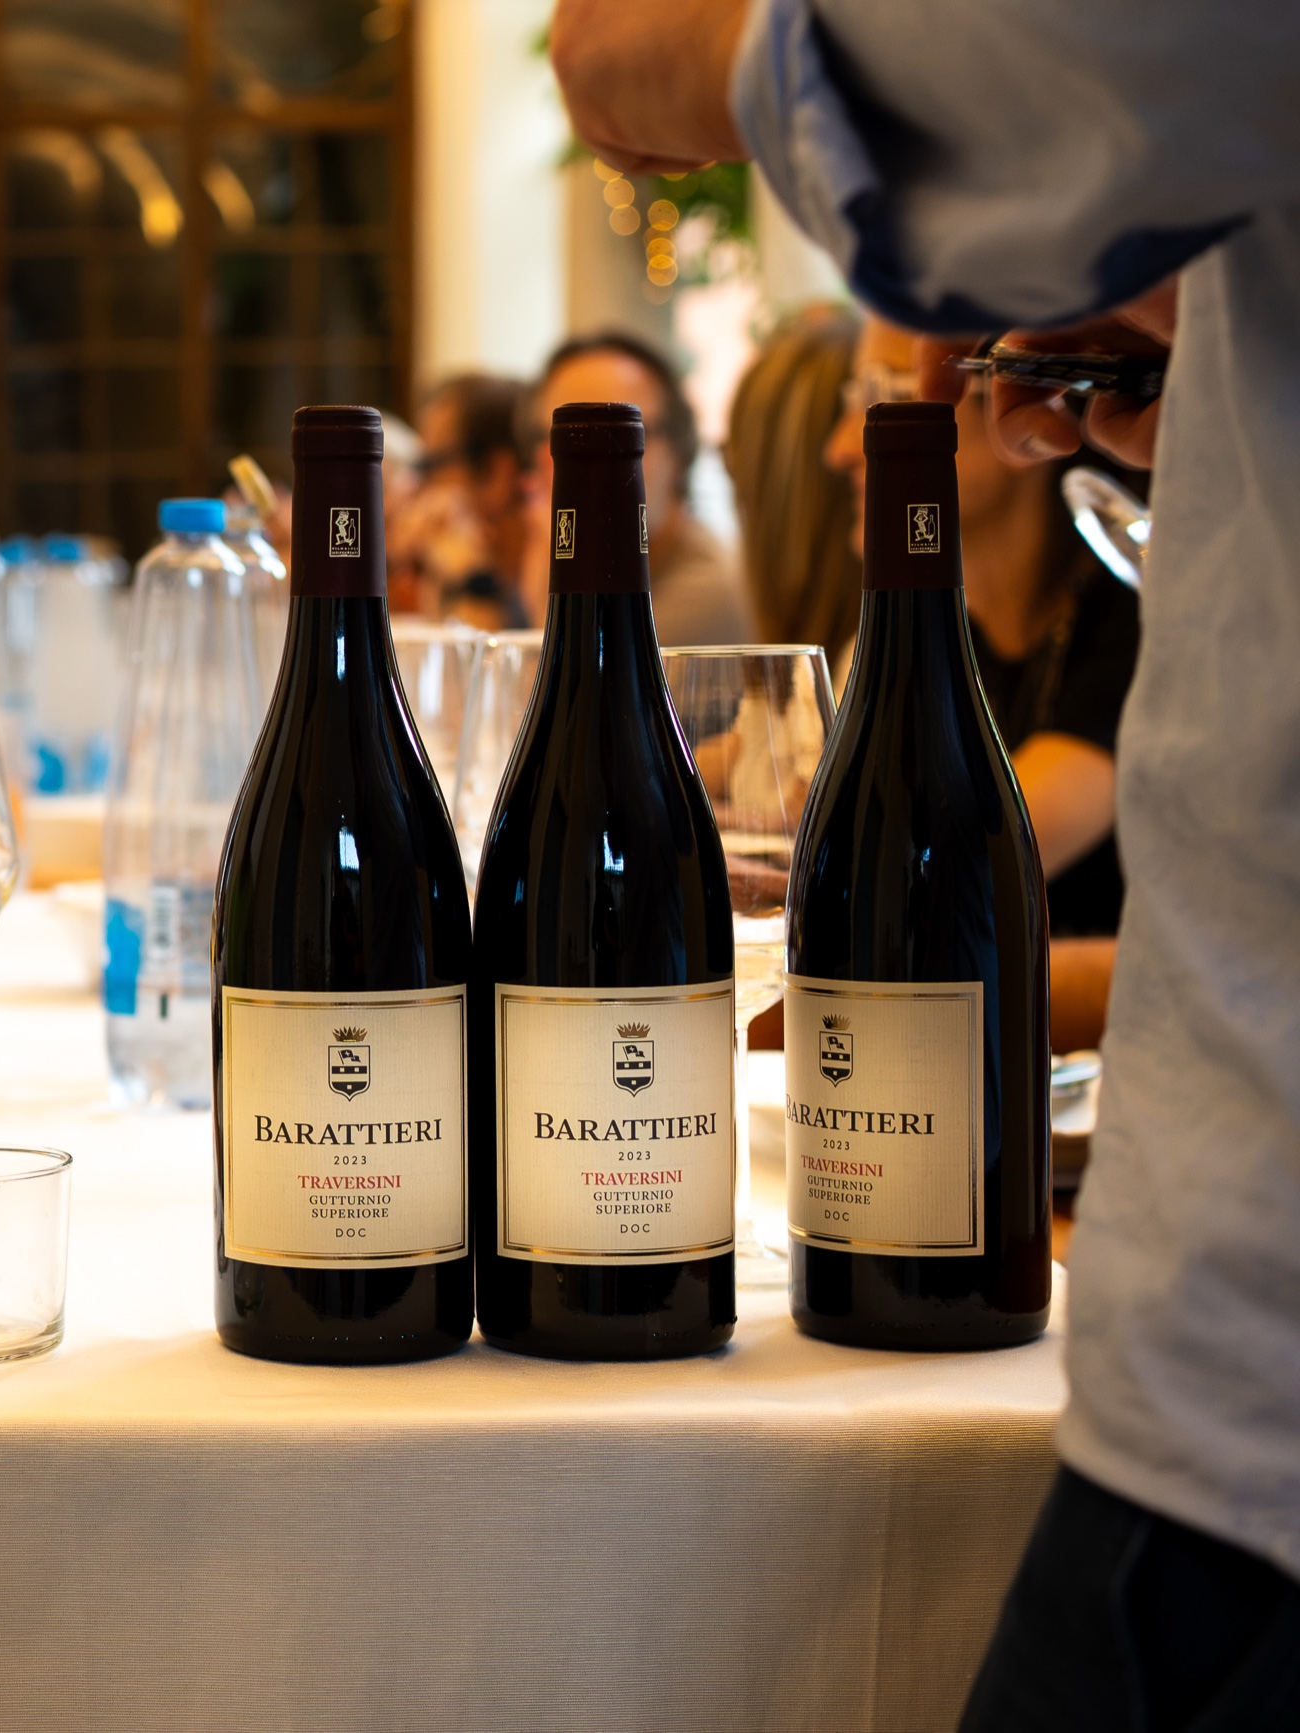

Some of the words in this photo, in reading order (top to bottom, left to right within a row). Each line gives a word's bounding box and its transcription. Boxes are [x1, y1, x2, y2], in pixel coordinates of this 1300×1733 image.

[786, 1093, 935, 1135] BARATTIERI
[254, 1115, 442, 1145] BARATTIERI
[534, 1112, 717, 1141] BARATTIERI
[822, 1138, 850, 1151] 2023
[333, 1155, 367, 1165] 2023
[618, 1151, 651, 1161] 2023
[801, 1155, 883, 1177] TRAVERSINI
[297, 1174, 402, 1190] TRAVERSINI
[581, 1170, 683, 1186] TRAVERSINI
[807, 1175, 873, 1192] GUTTURNIO
[309, 1194, 391, 1205] GUTTURNIO
[593, 1189, 674, 1202] GUTTURNIO
[808, 1188, 871, 1205] SUPERIORE
[311, 1208, 389, 1219] SUPERIORE
[595, 1203, 672, 1215] SUPERIORE
[824, 1209, 850, 1222] DOC
[335, 1228, 366, 1238] DOC
[620, 1223, 650, 1234] DOC
